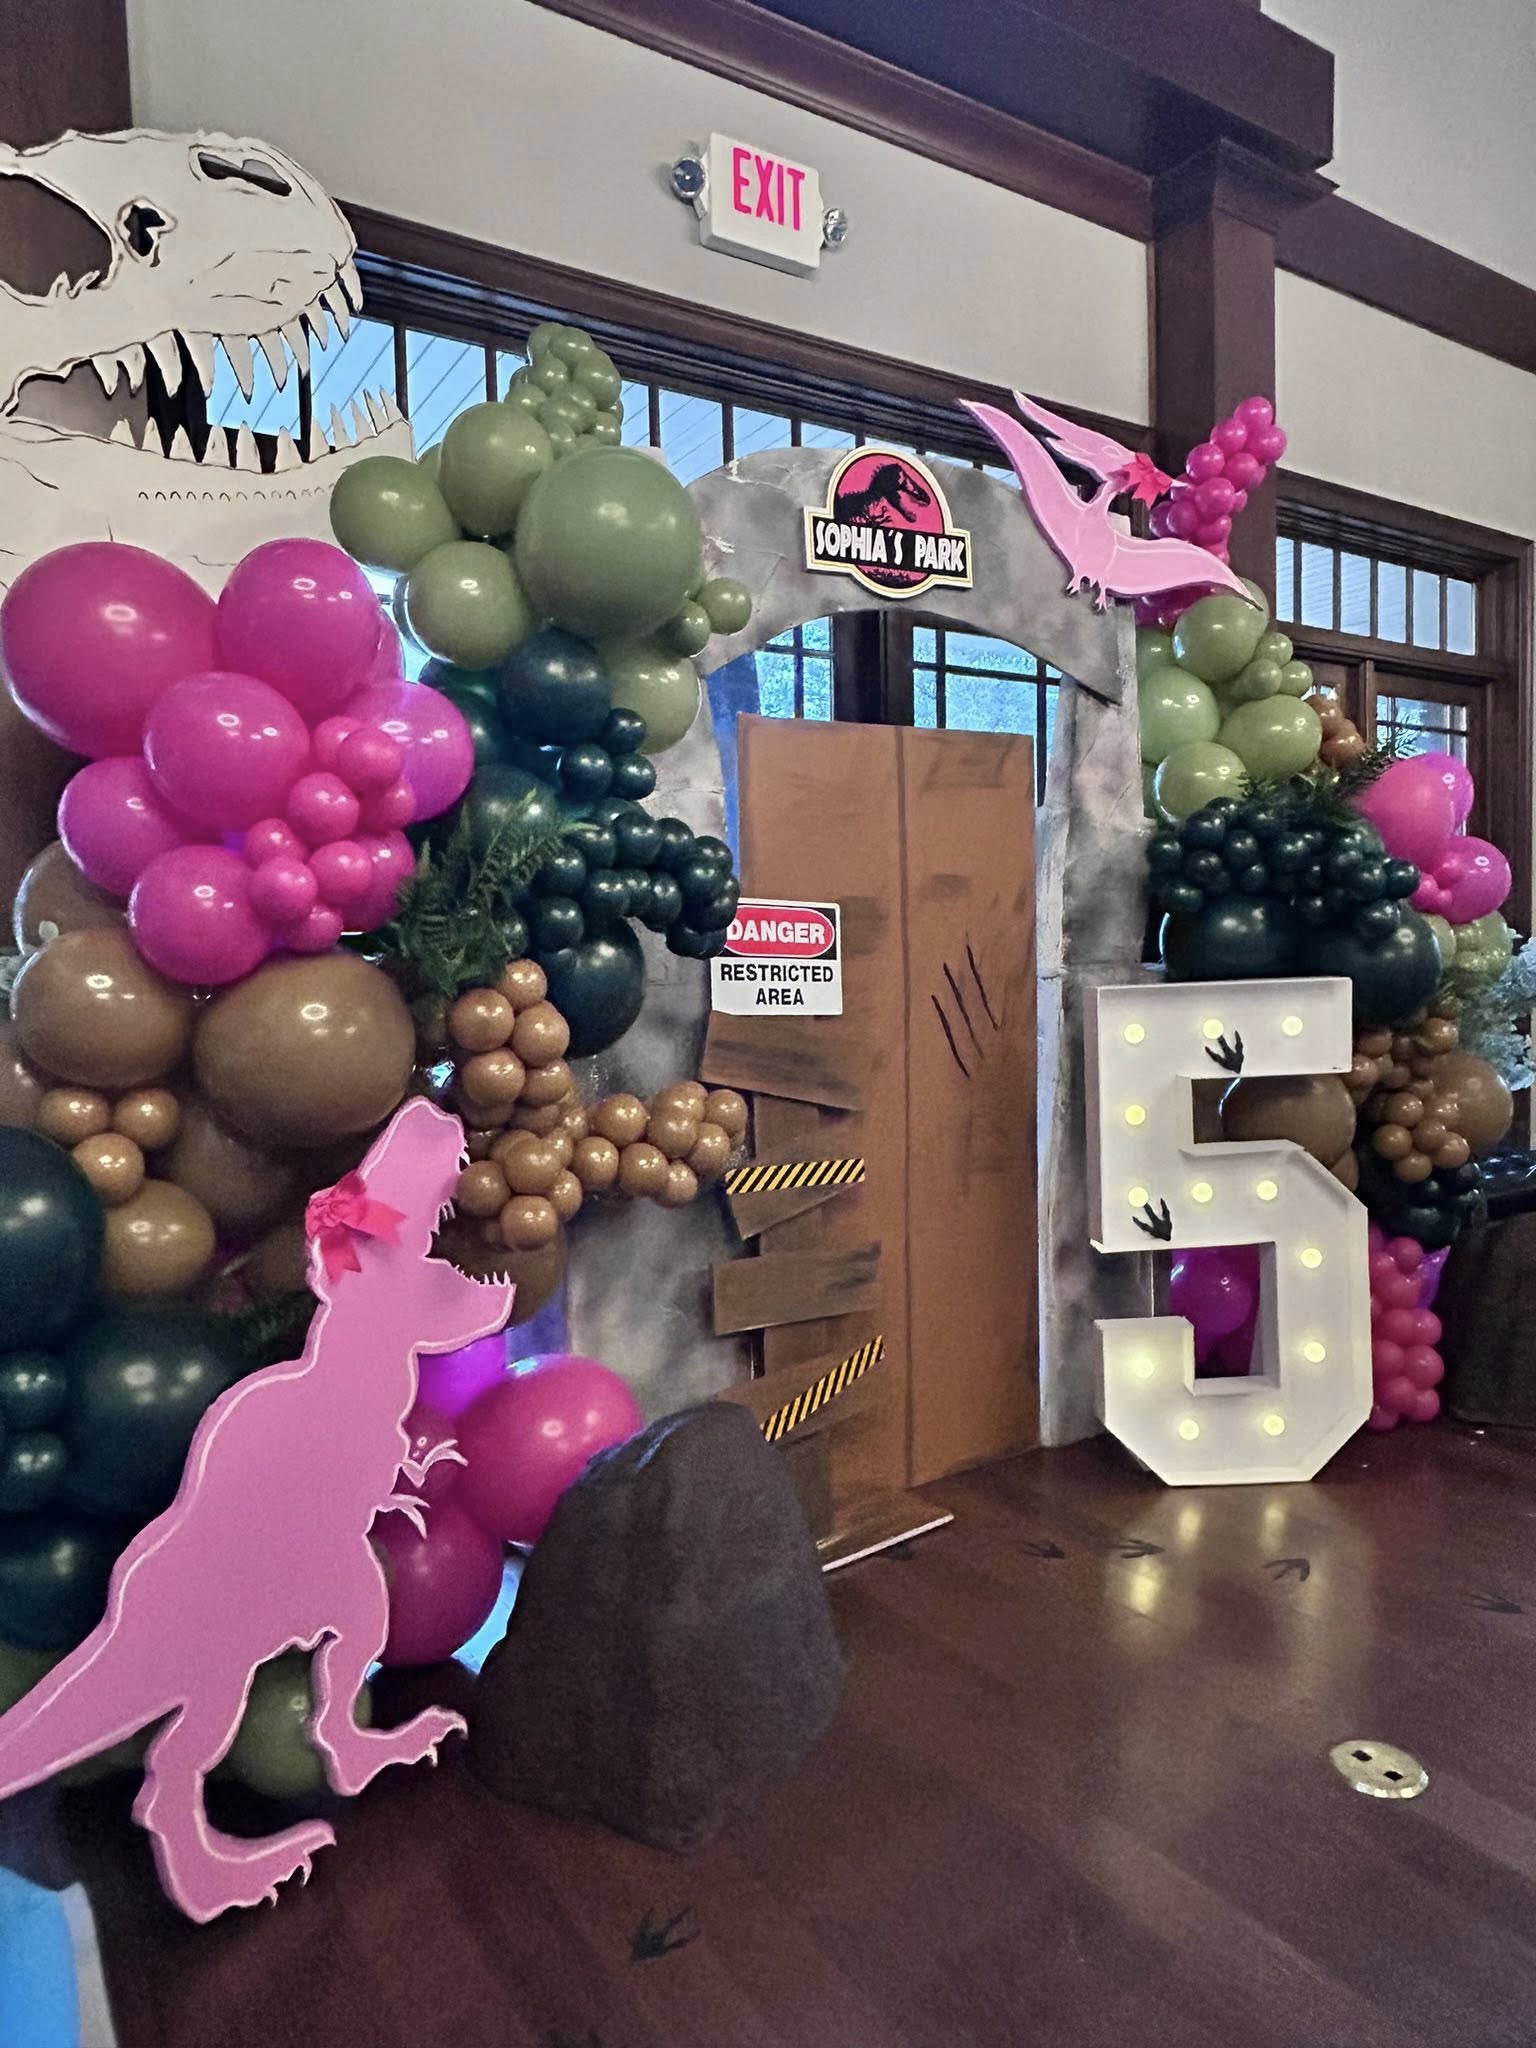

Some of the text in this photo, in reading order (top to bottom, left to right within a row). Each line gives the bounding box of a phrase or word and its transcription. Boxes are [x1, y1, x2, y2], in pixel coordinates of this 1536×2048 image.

[733, 147, 805, 231] EXIT
[815, 520, 965, 572] SOPHIA'S PARK
[727, 919, 826, 944] DANGER
[720, 963, 834, 983] RESTRICTED
[755, 988, 805, 1006] AREA
[1088, 977, 1374, 1487] 5
